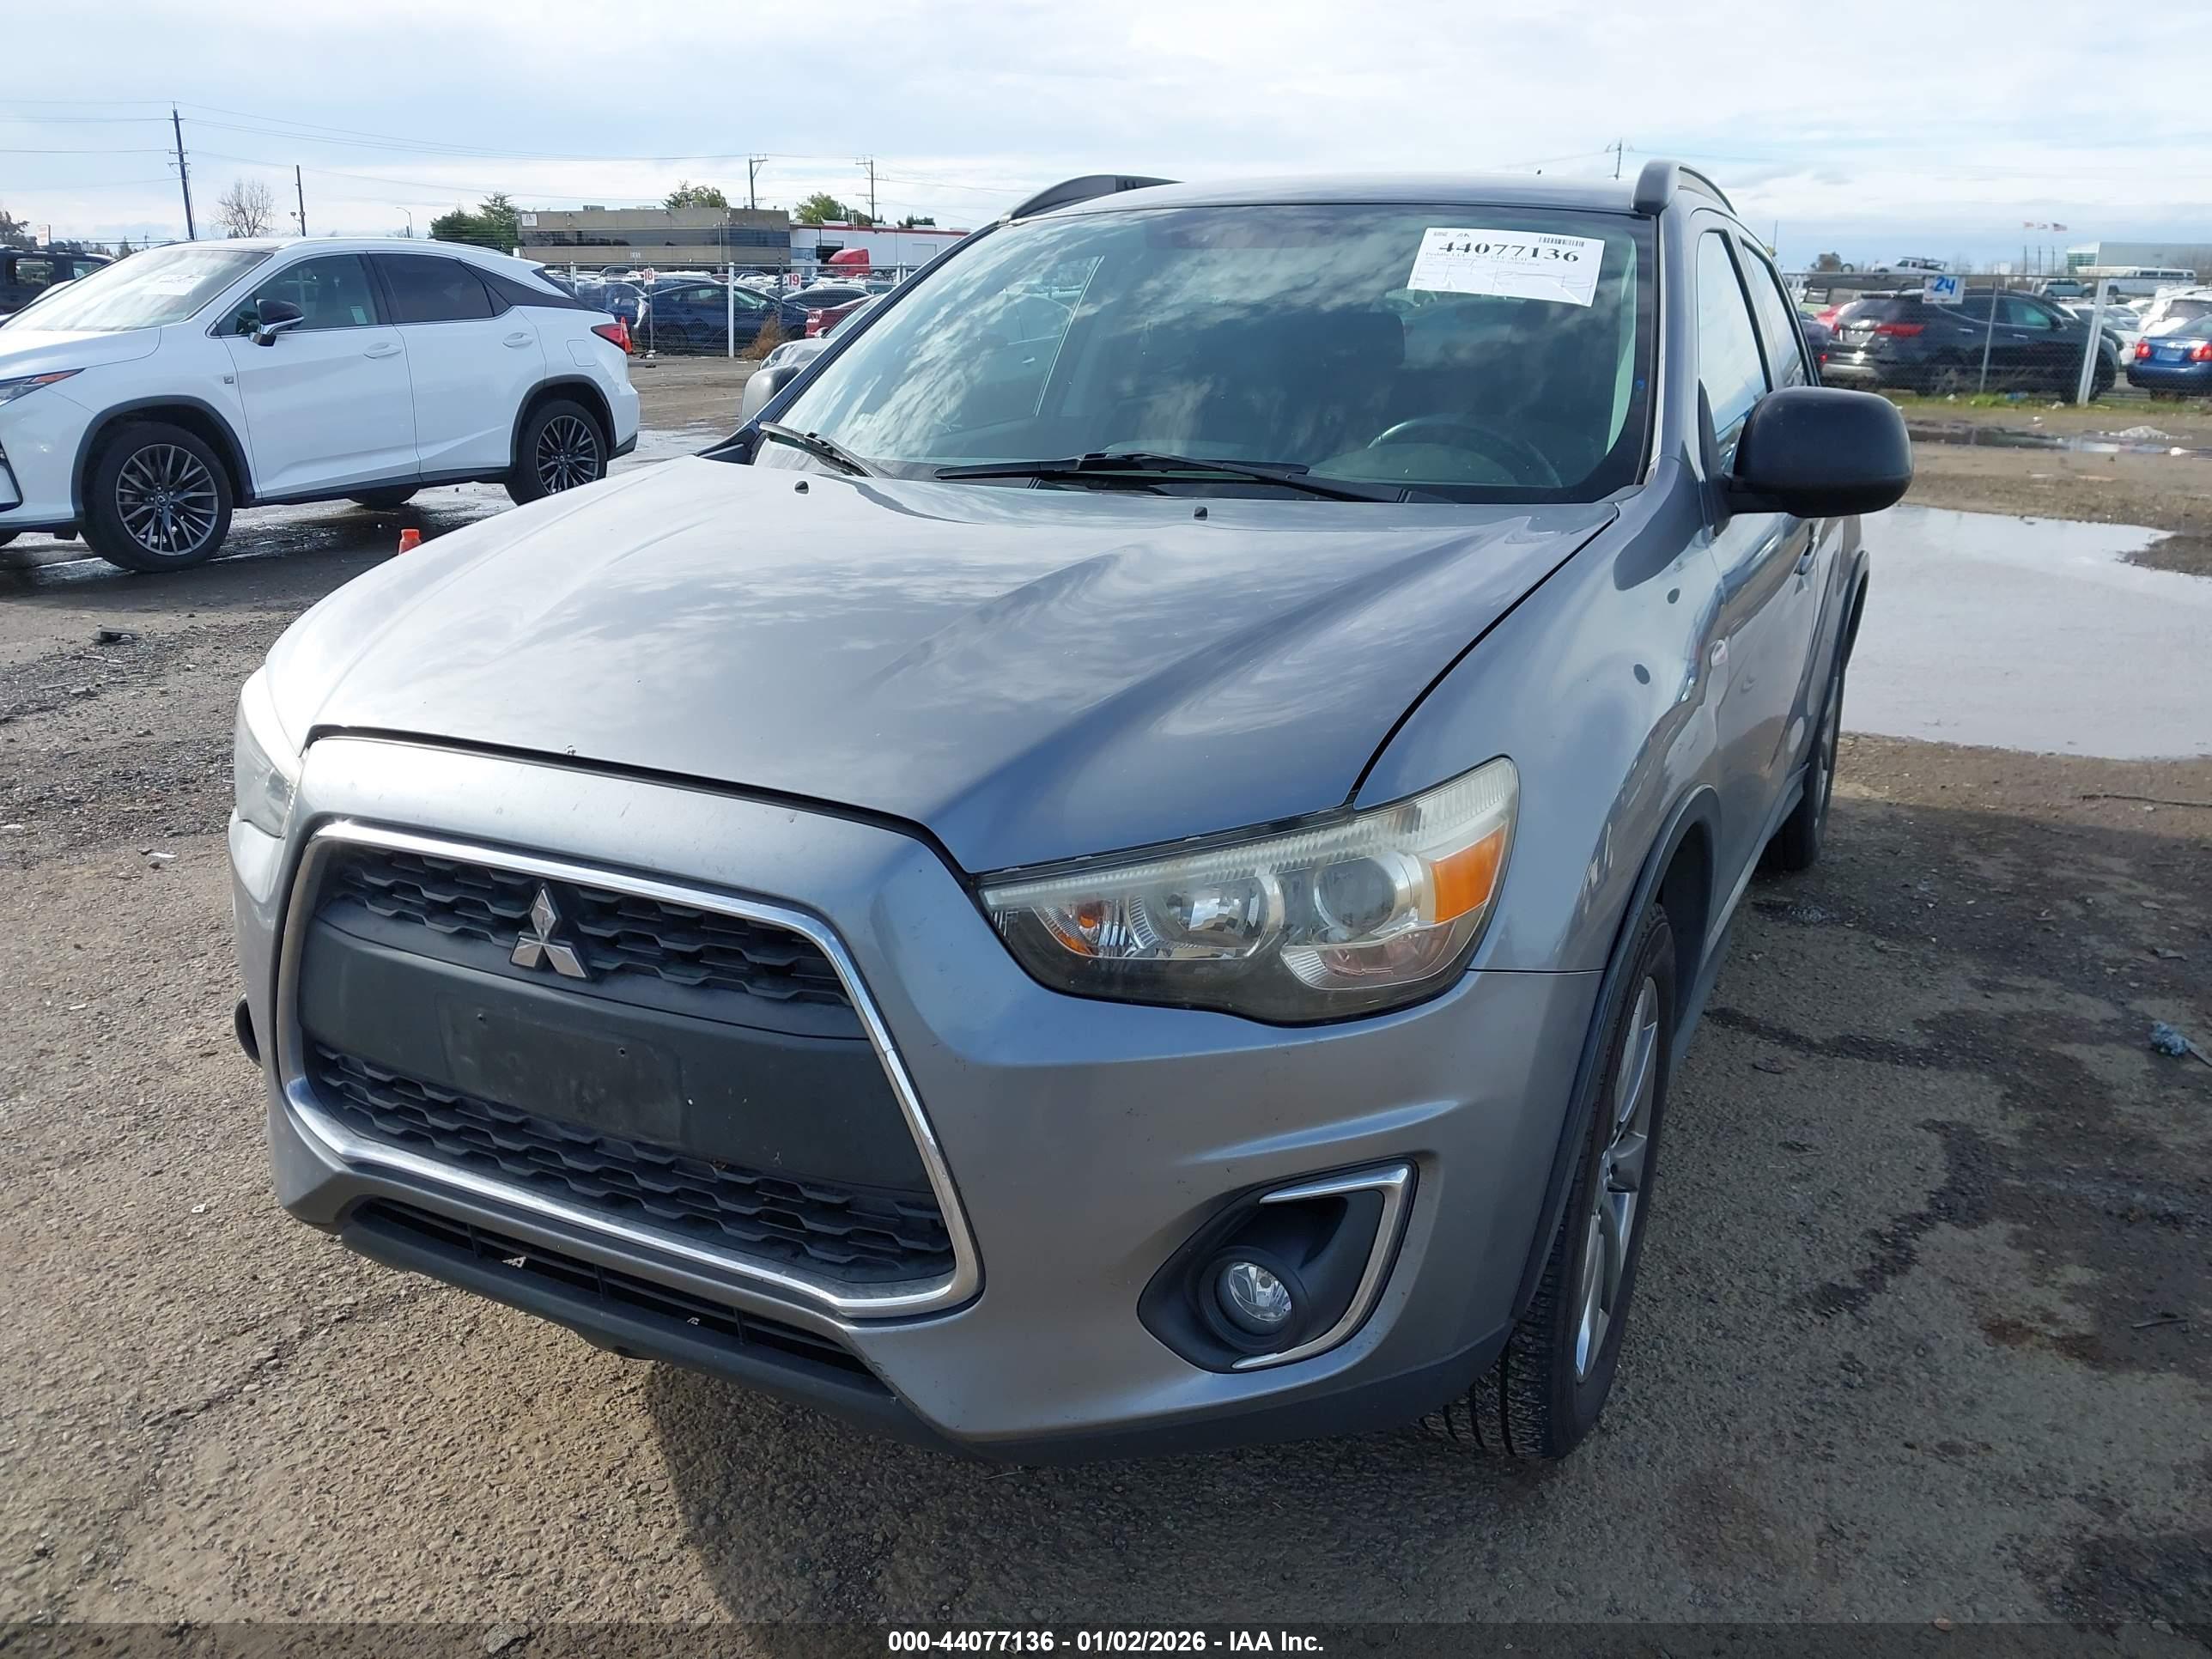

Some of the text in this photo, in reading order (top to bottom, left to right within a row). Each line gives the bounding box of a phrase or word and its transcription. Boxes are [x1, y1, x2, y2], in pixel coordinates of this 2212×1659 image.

[1438, 241, 1579, 263] 44077136
[644, 270, 653, 281] 18
[788, 274, 800, 287] 19
[1934, 276, 1956, 295] 24
